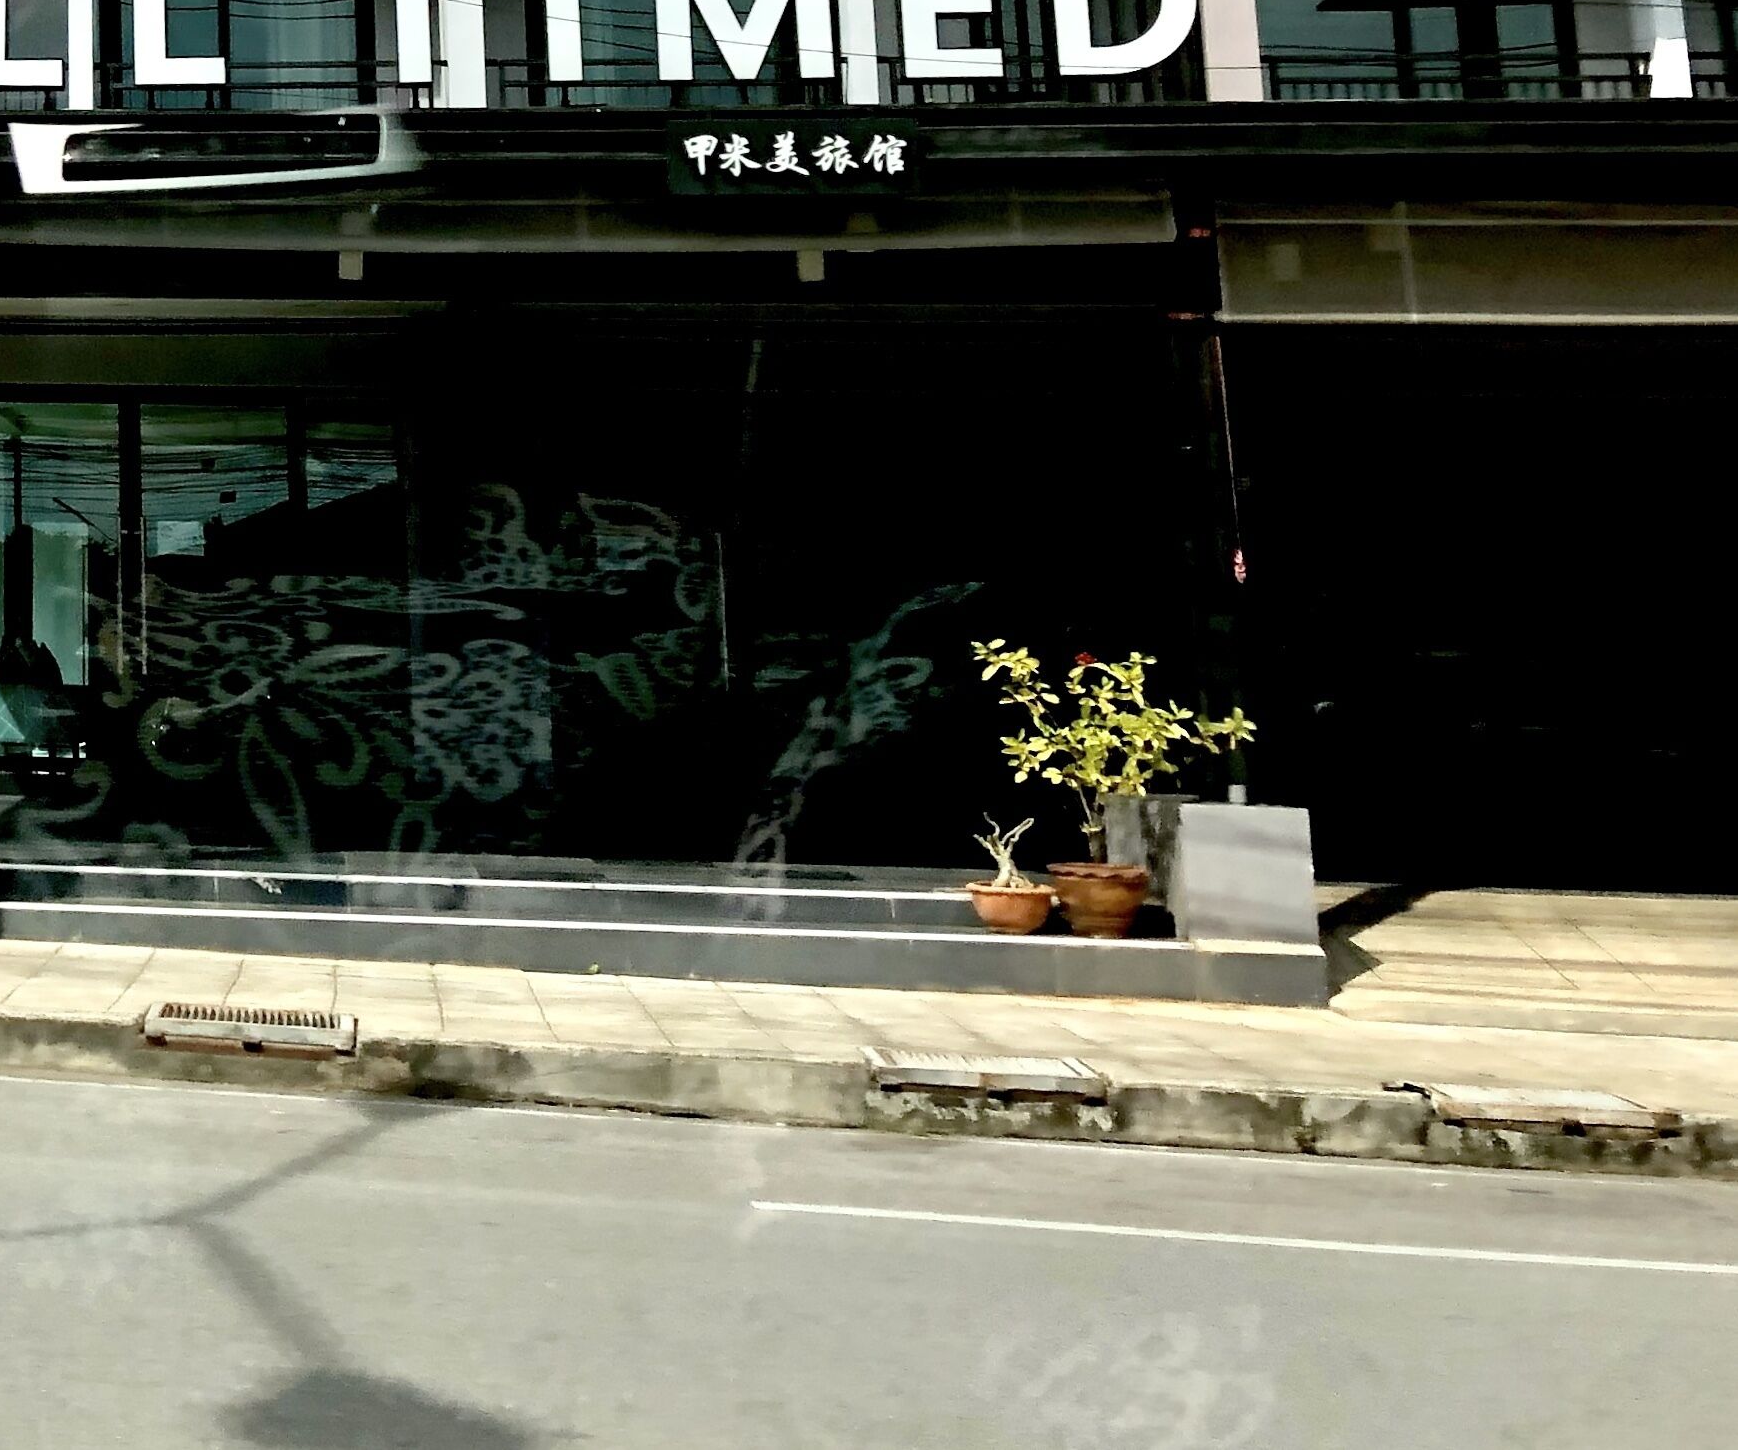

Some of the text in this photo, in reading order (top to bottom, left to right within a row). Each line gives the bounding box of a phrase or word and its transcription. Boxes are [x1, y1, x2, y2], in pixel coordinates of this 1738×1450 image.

[683, 130, 908, 177] 甲米美旅馆
